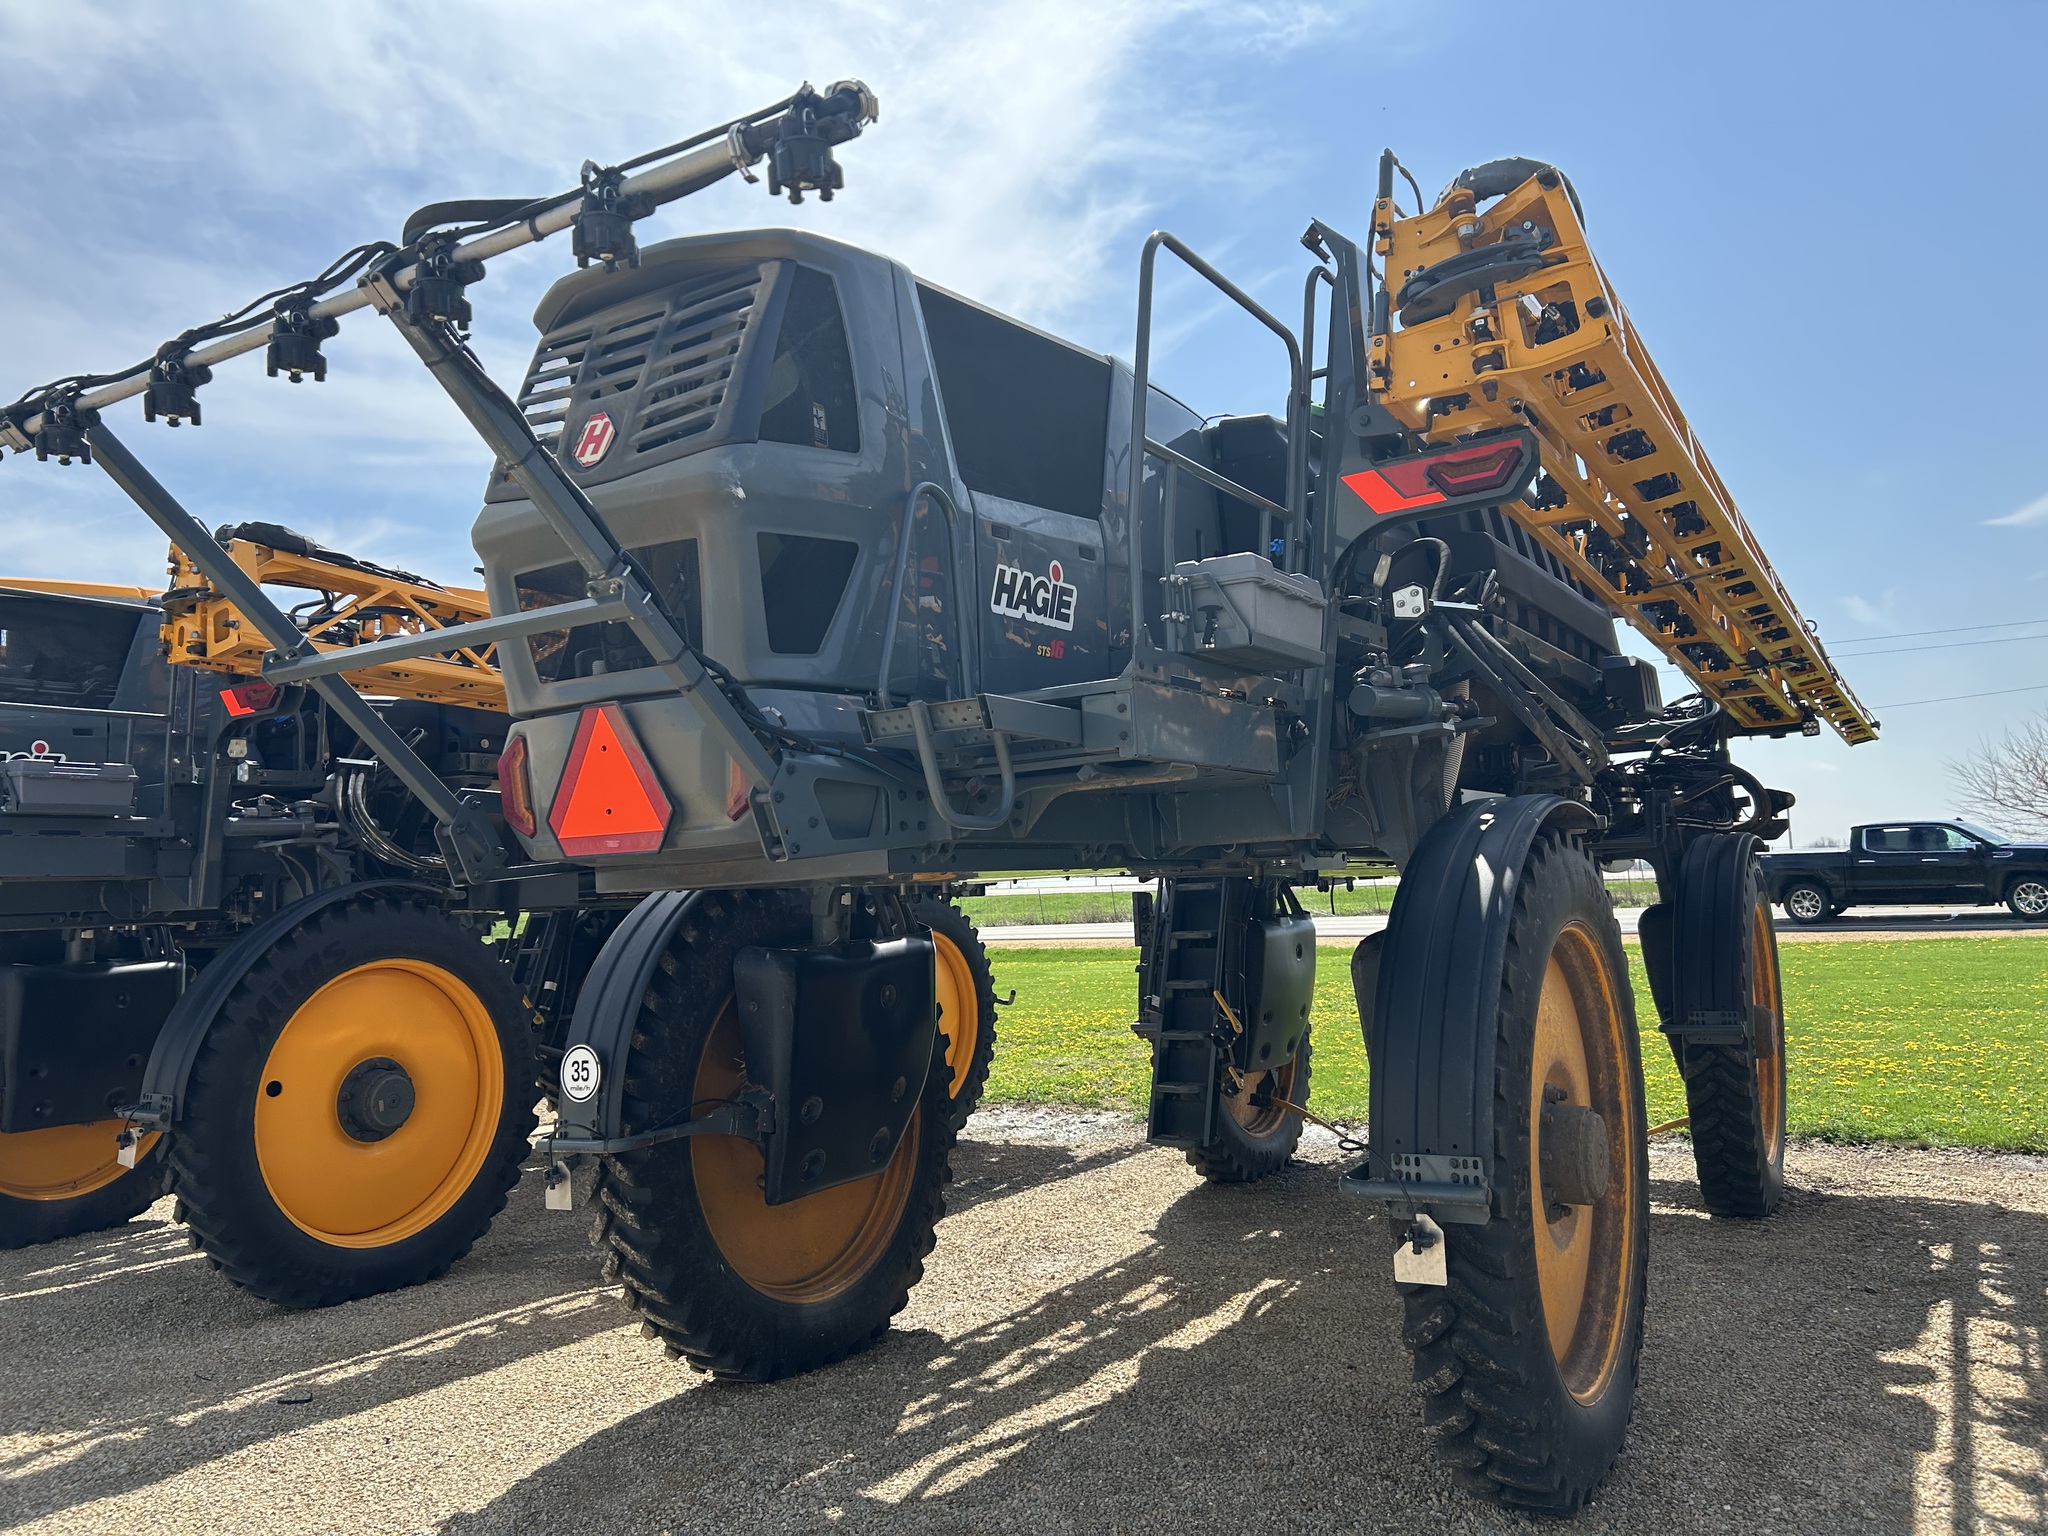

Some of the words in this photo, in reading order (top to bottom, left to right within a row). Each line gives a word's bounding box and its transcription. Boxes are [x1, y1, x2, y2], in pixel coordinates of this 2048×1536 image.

[576, 419, 612, 460] H
[992, 562, 1075, 627] HAGIE
[571, 1060, 590, 1082] 35
